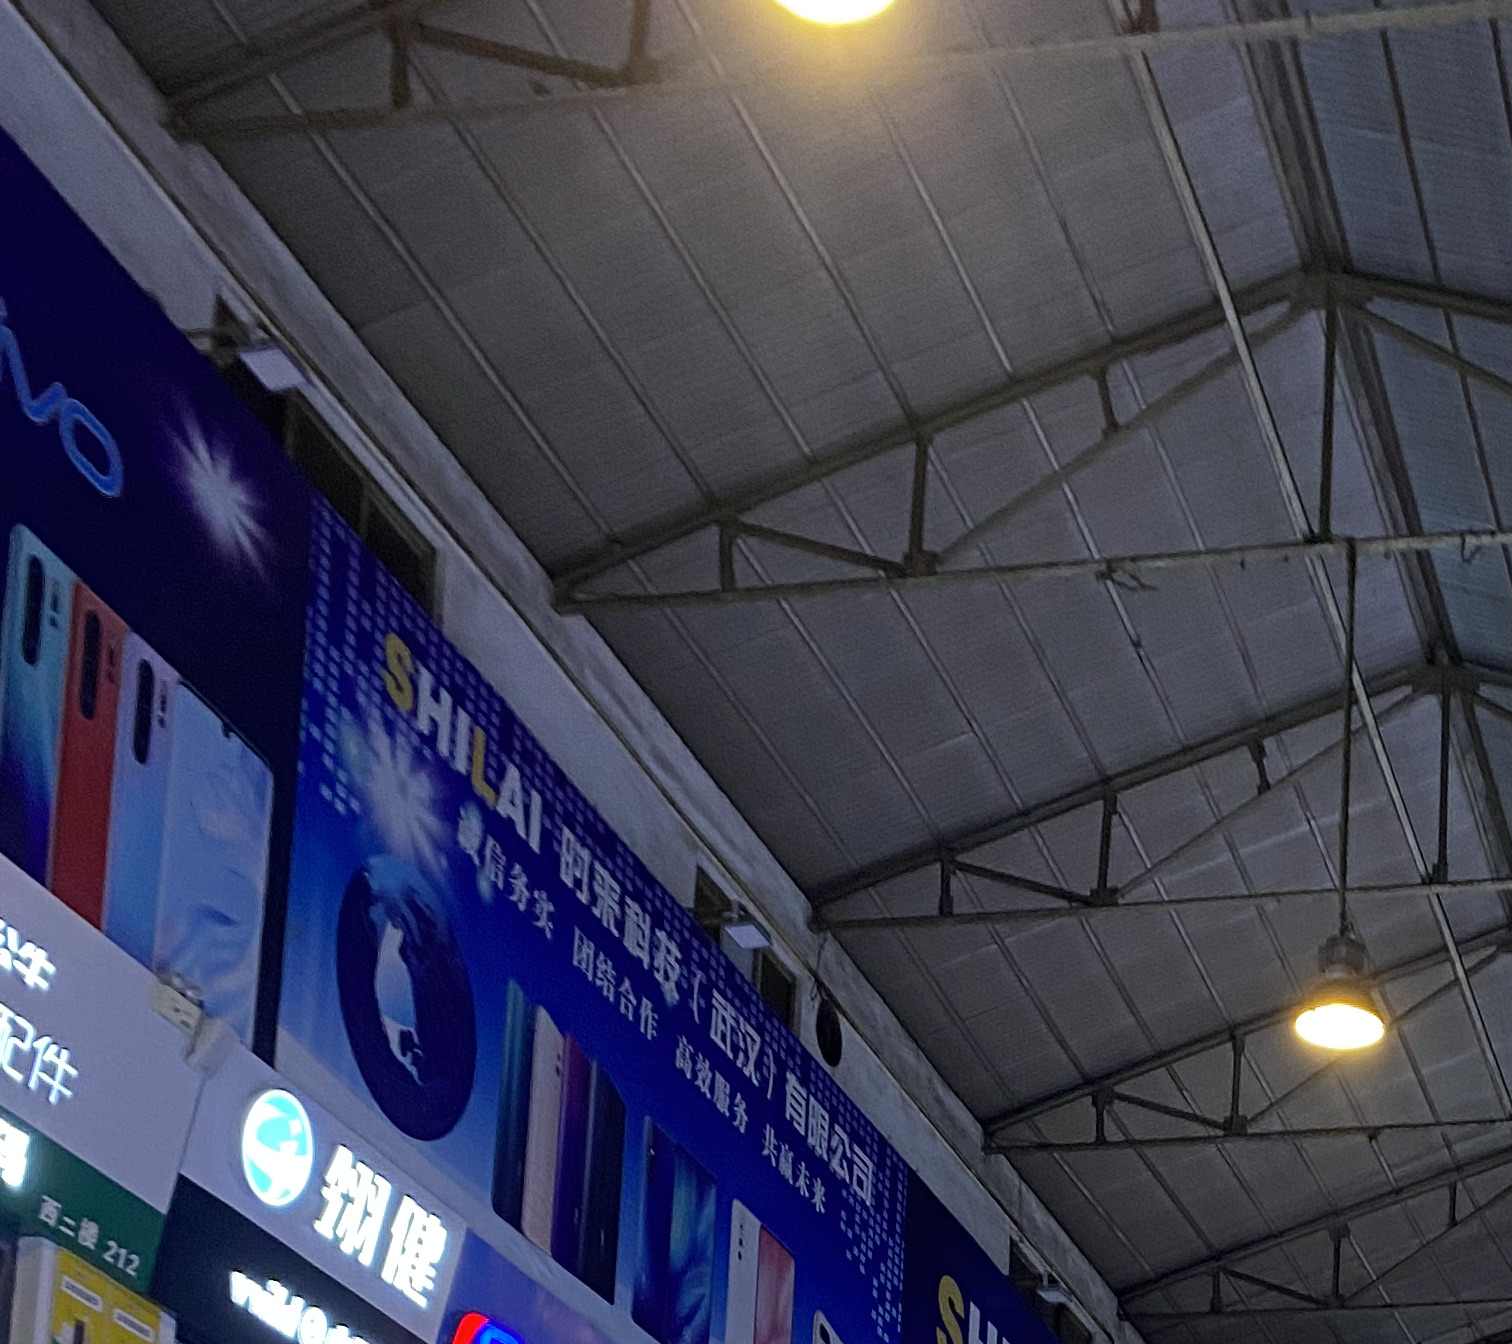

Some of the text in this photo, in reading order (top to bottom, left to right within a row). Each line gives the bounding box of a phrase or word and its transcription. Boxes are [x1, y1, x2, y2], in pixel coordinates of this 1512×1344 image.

[383, 633, 544, 853] SHILAI
[572, 926, 659, 1041] 团结合作
[675, 1033, 749, 1135] 高效服务
[103, 1238, 141, 1278] 212
